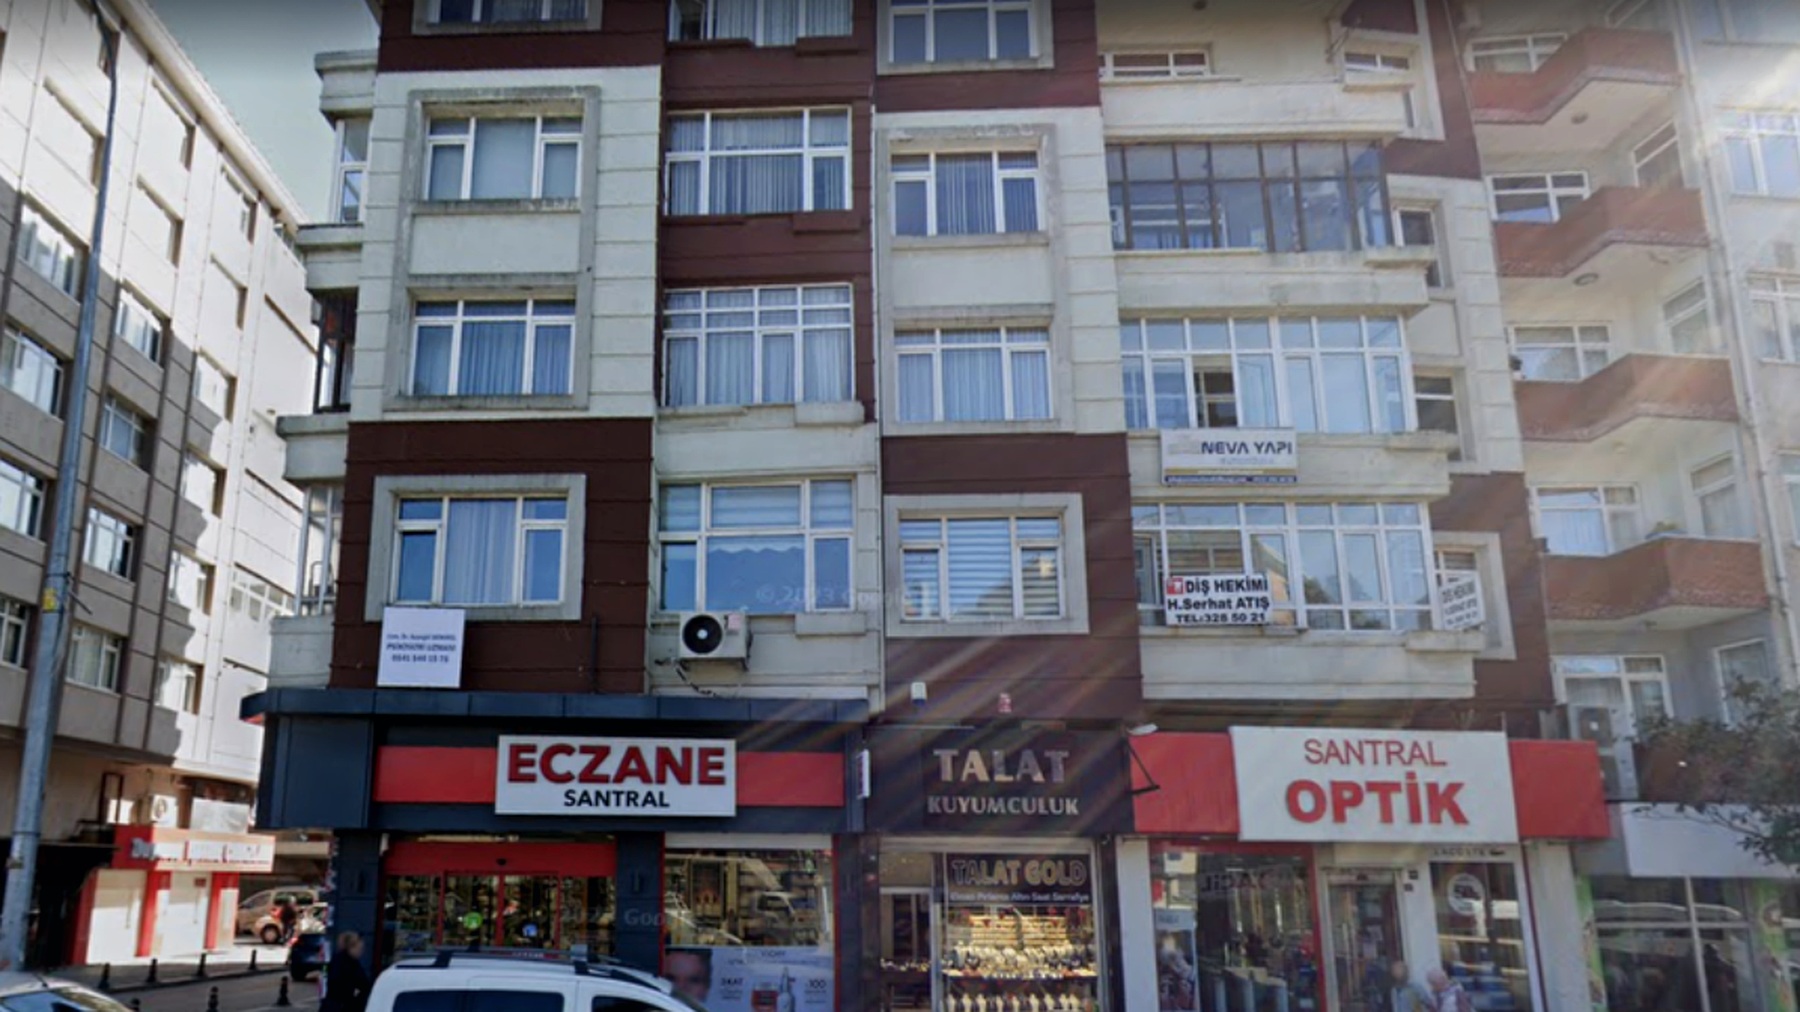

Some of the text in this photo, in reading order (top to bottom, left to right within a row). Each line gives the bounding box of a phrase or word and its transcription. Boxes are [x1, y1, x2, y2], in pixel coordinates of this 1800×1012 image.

[1201, 441, 1293, 455] NEVA YAPI
[1185, 577, 1211, 595] DİŞ
[1167, 598, 1233, 611] H.Serhat
[507, 743, 727, 786] ECZANE
[1303, 738, 1448, 767] SANTRAL
[932, 749, 1070, 783] TALAT
[563, 789, 670, 809] SANTRAL
[927, 795, 1081, 816] KUYUMCULUK
[1285, 771, 1470, 826] OPTİK
[951, 859, 1088, 887] TALAT GOLD
